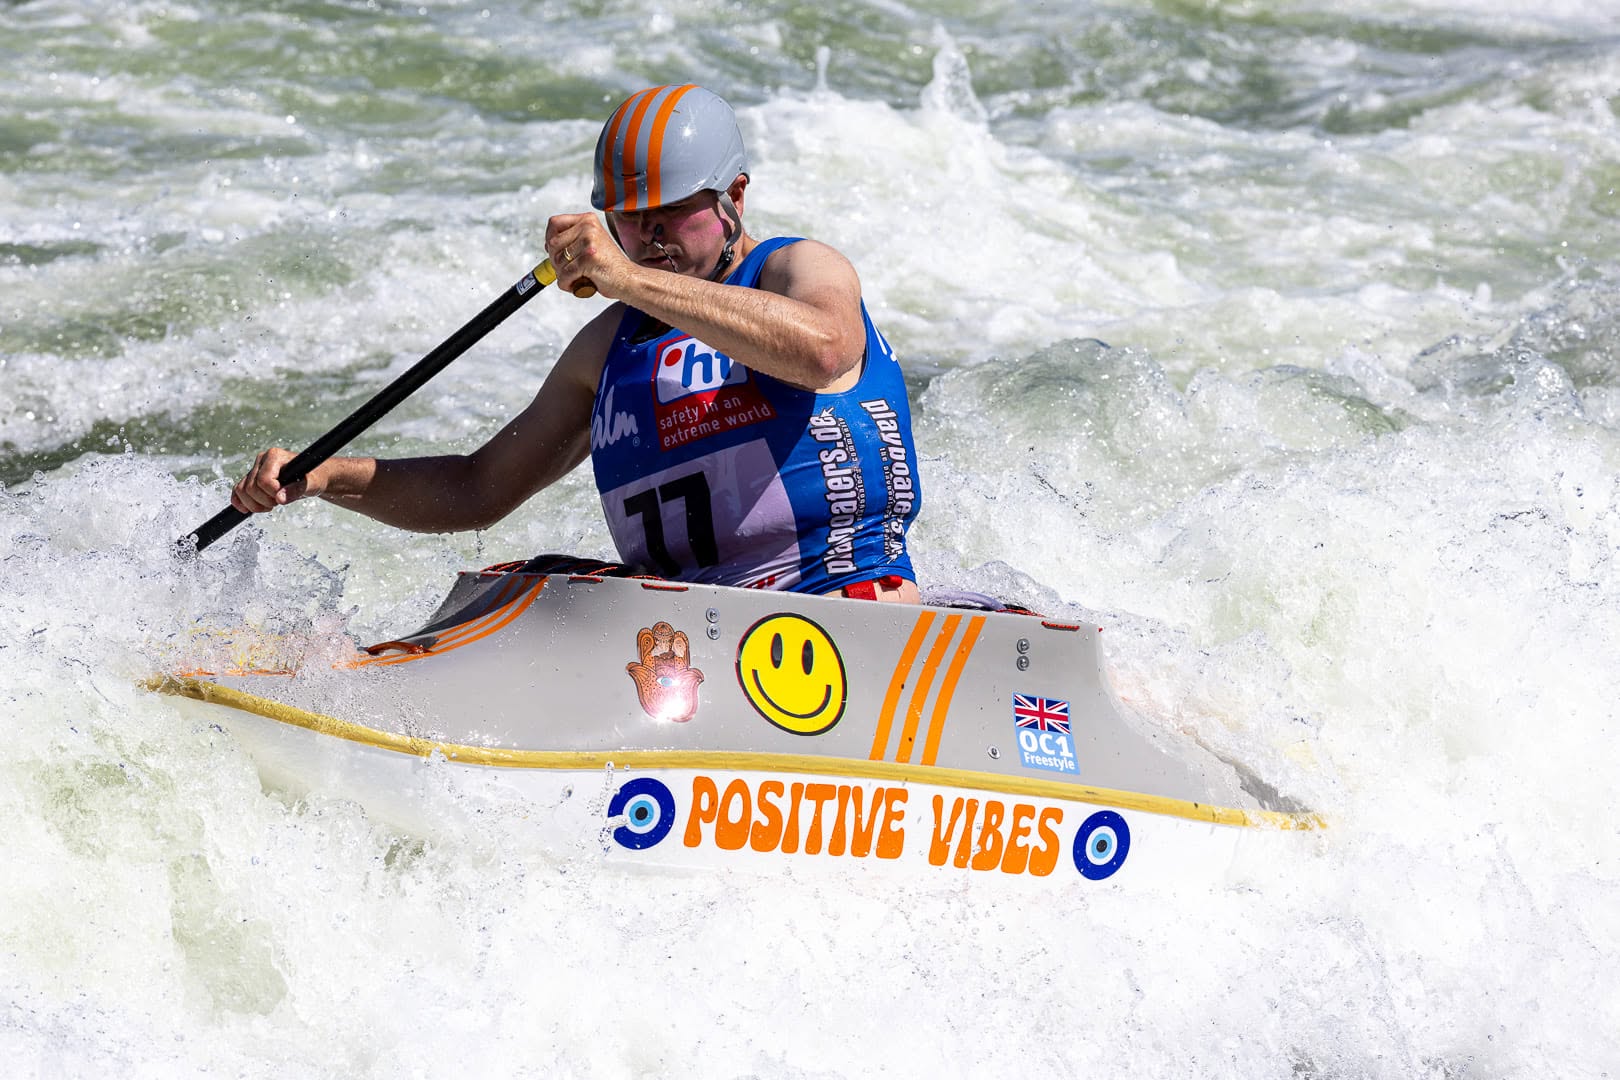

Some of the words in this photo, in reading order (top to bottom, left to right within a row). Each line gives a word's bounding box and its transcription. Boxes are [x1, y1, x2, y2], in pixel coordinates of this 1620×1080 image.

[591, 366, 639, 452] alm
[660, 405, 699, 431] safety
[703, 401, 718, 414] in
[724, 397, 741, 409] an
[663, 419, 721, 447] extreme
[725, 404, 771, 427] world
[623, 471, 719, 576] 77
[1019, 730, 1074, 758] OC1
[1023, 752, 1076, 771] Freestyle
[683, 775, 908, 860] POSITIVE
[928, 794, 1064, 877] VIBES
